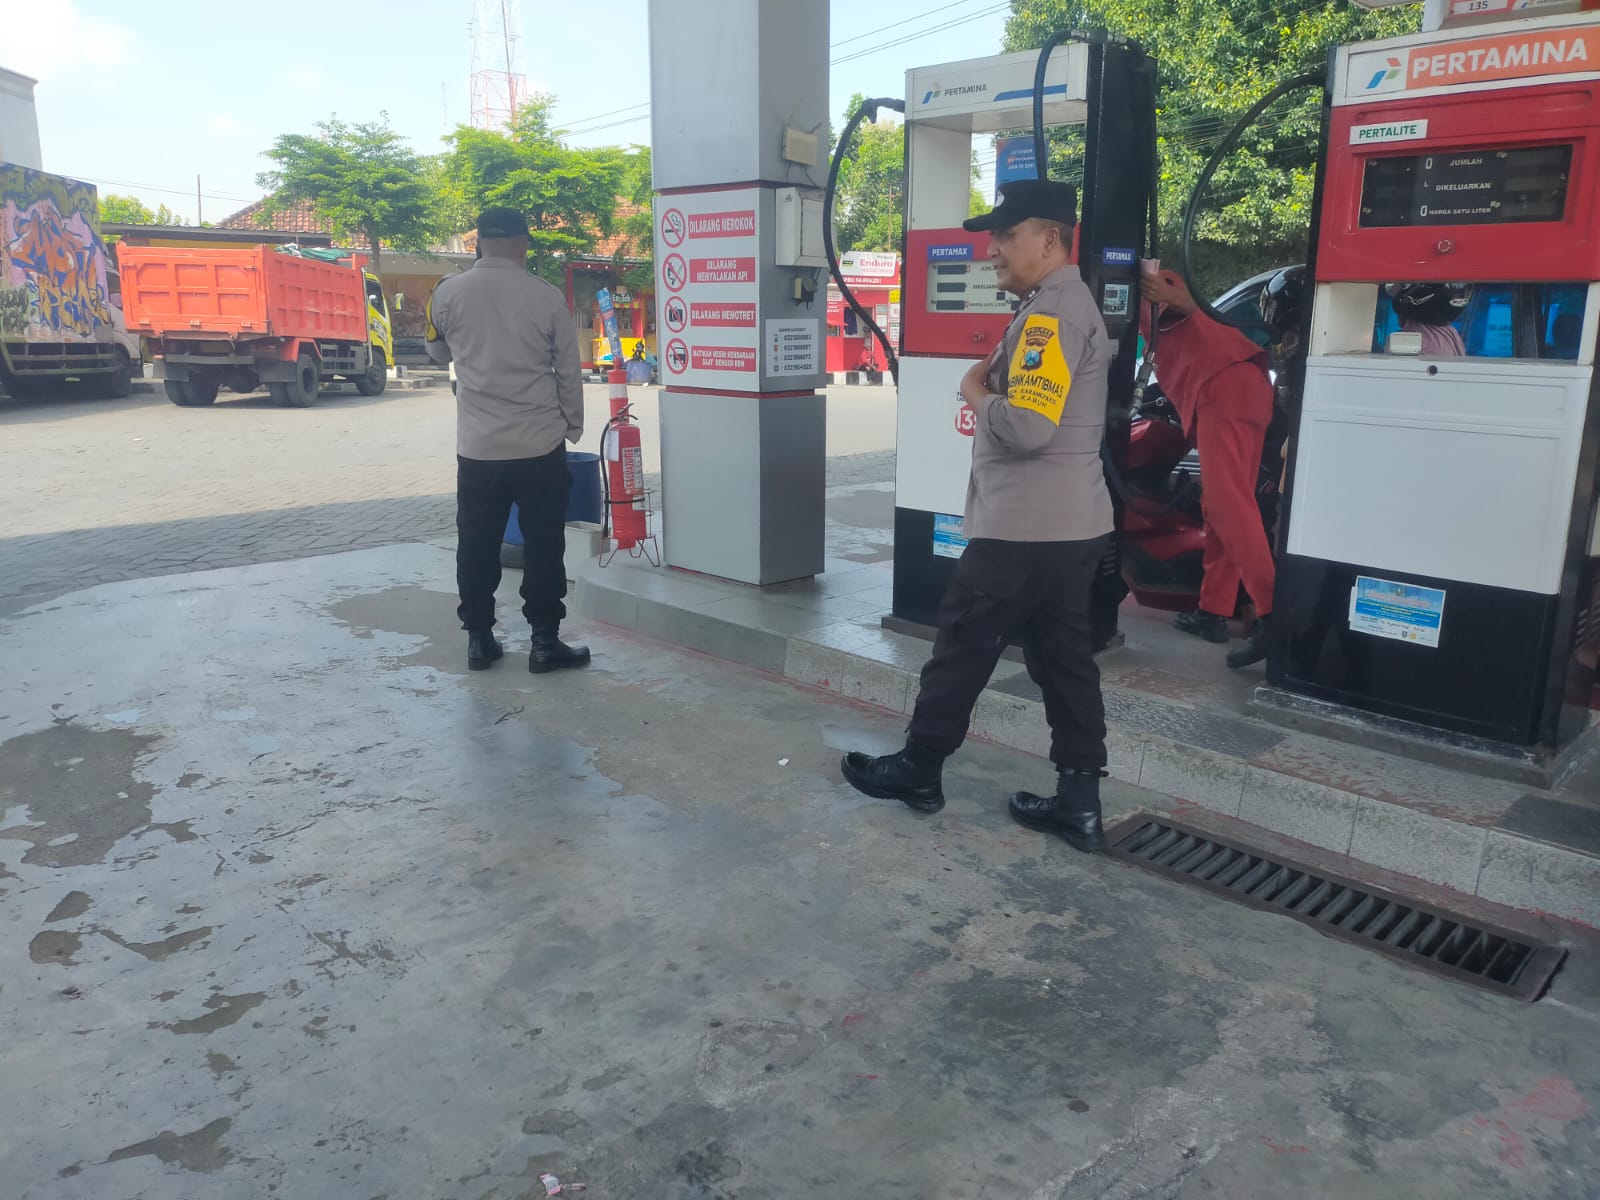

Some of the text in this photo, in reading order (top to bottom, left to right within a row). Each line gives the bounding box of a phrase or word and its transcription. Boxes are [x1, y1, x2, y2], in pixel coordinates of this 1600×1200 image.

[1468, 0, 1488, 11] 135
[1412, 38, 1588, 79] PERTAMINA
[944, 83, 987, 96] PERTAMINA
[1359, 125, 1417, 139] PERTALITE
[1449, 158, 1483, 167] JUMLAH
[1435, 182, 1491, 191] DIKELUARKAN
[689, 216, 754, 233] DILARANG MEROKOK
[932, 247, 968, 256] PERTAMAX
[1106, 251, 1131, 261] PERTAMAX
[706, 259, 736, 269] DILARANG
[860, 259, 893, 267] Enduro
[697, 271, 748, 281] MENYALAKAN API
[691, 310, 754, 320] DILARANG MEMOTRET
[1021, 395, 1046, 408] KABUH
[956, 410, 976, 430] 13
